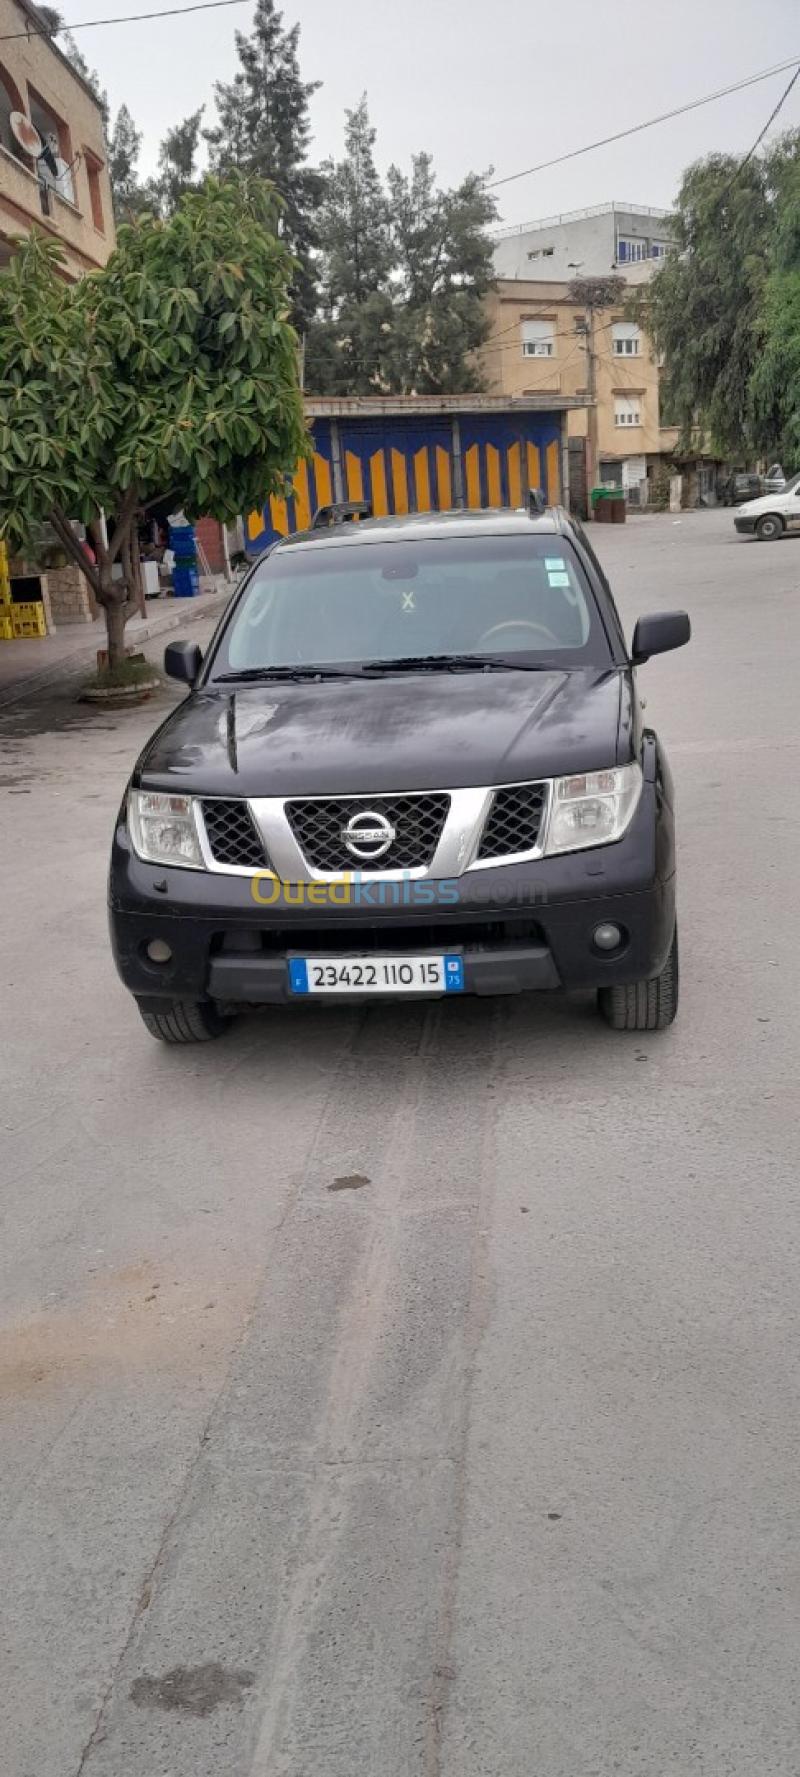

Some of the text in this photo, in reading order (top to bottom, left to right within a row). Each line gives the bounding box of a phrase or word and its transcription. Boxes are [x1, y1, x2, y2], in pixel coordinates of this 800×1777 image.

[341, 831, 390, 841] NISSAN
[313, 966, 377, 986] 23422
[384, 964, 413, 985] 110
[420, 963, 439, 984] 15
[448, 975, 460, 985] 75
